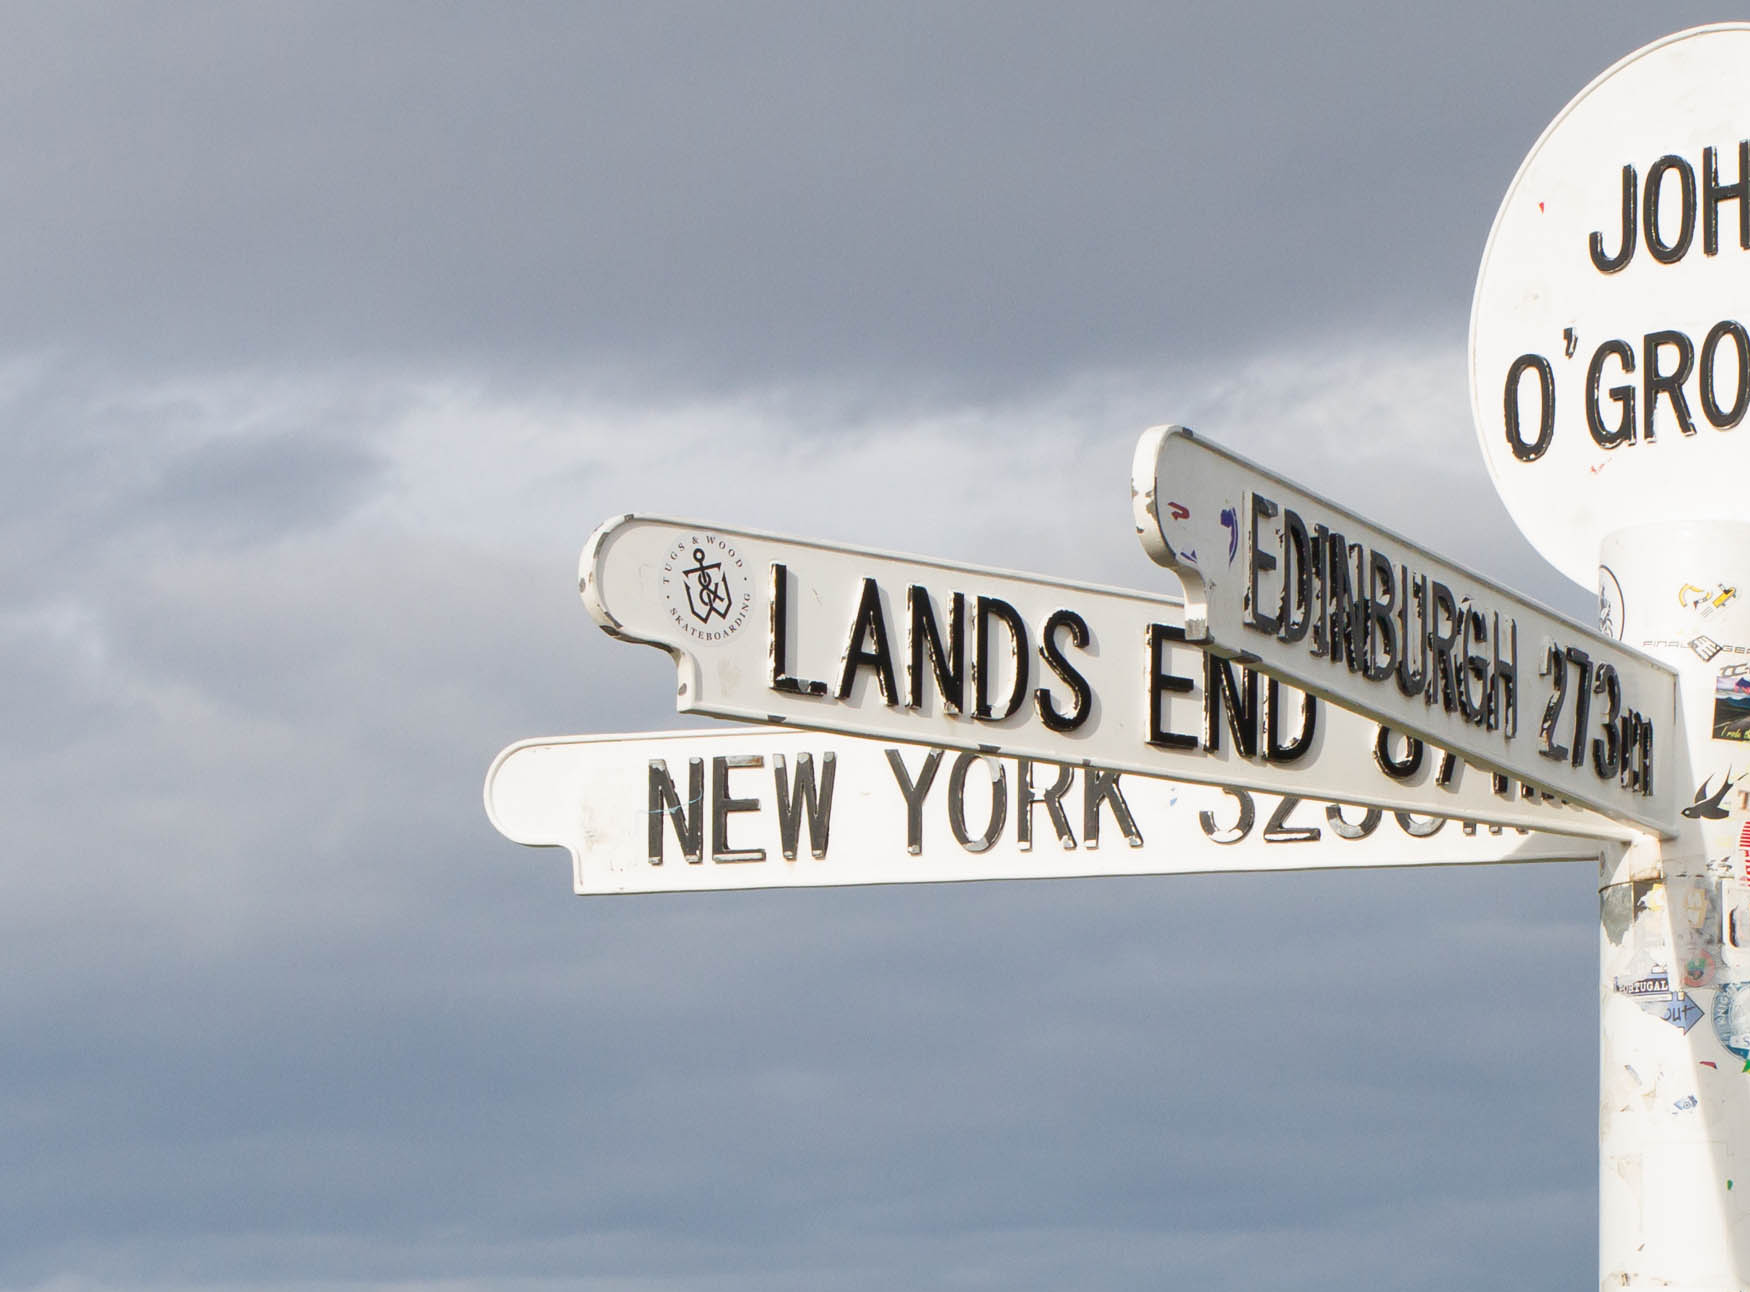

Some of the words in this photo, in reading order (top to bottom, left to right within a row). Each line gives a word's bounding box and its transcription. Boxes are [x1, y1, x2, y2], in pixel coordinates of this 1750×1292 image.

[663, 543, 686, 585] TUGS
[691, 535, 700, 545] &
[706, 535, 744, 569] WOOD
[670, 592, 751, 641] SKATEBOARDING
[767, 561, 1092, 733] LANDS
[1144, 622, 1318, 764] END
[1243, 488, 1518, 739] EDINBURGH
[1538, 641, 1655, 797] 273m
[647, 750, 838, 867] NEW
[884, 746, 1145, 857] YORK
